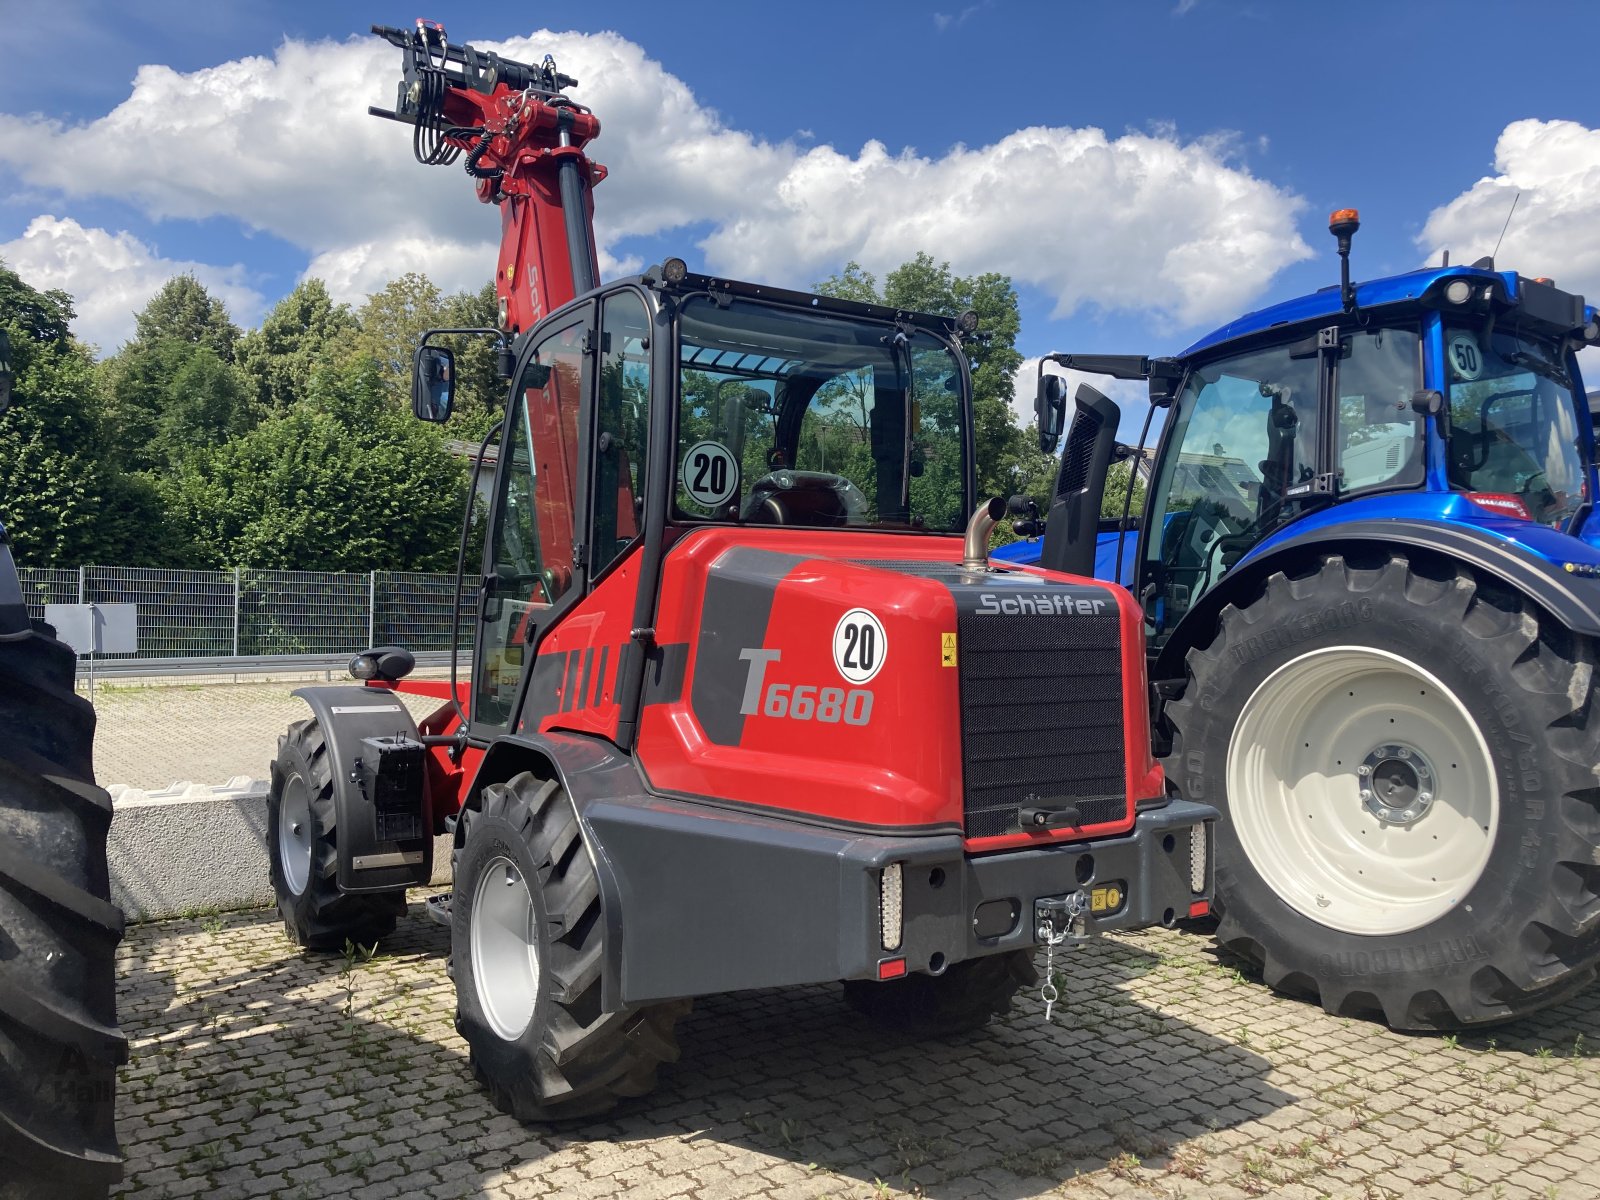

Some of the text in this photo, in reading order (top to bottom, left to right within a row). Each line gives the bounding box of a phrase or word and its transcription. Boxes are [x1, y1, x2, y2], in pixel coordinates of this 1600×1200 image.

[1454, 343, 1477, 372] 50
[693, 453, 727, 495] 20
[975, 594, 1106, 615] Schäffer
[843, 623, 875, 671] 20
[1231, 597, 1376, 665] TRELLEBORG
[738, 648, 875, 726] T6680
[1318, 933, 1491, 978] TRELLEBORG
